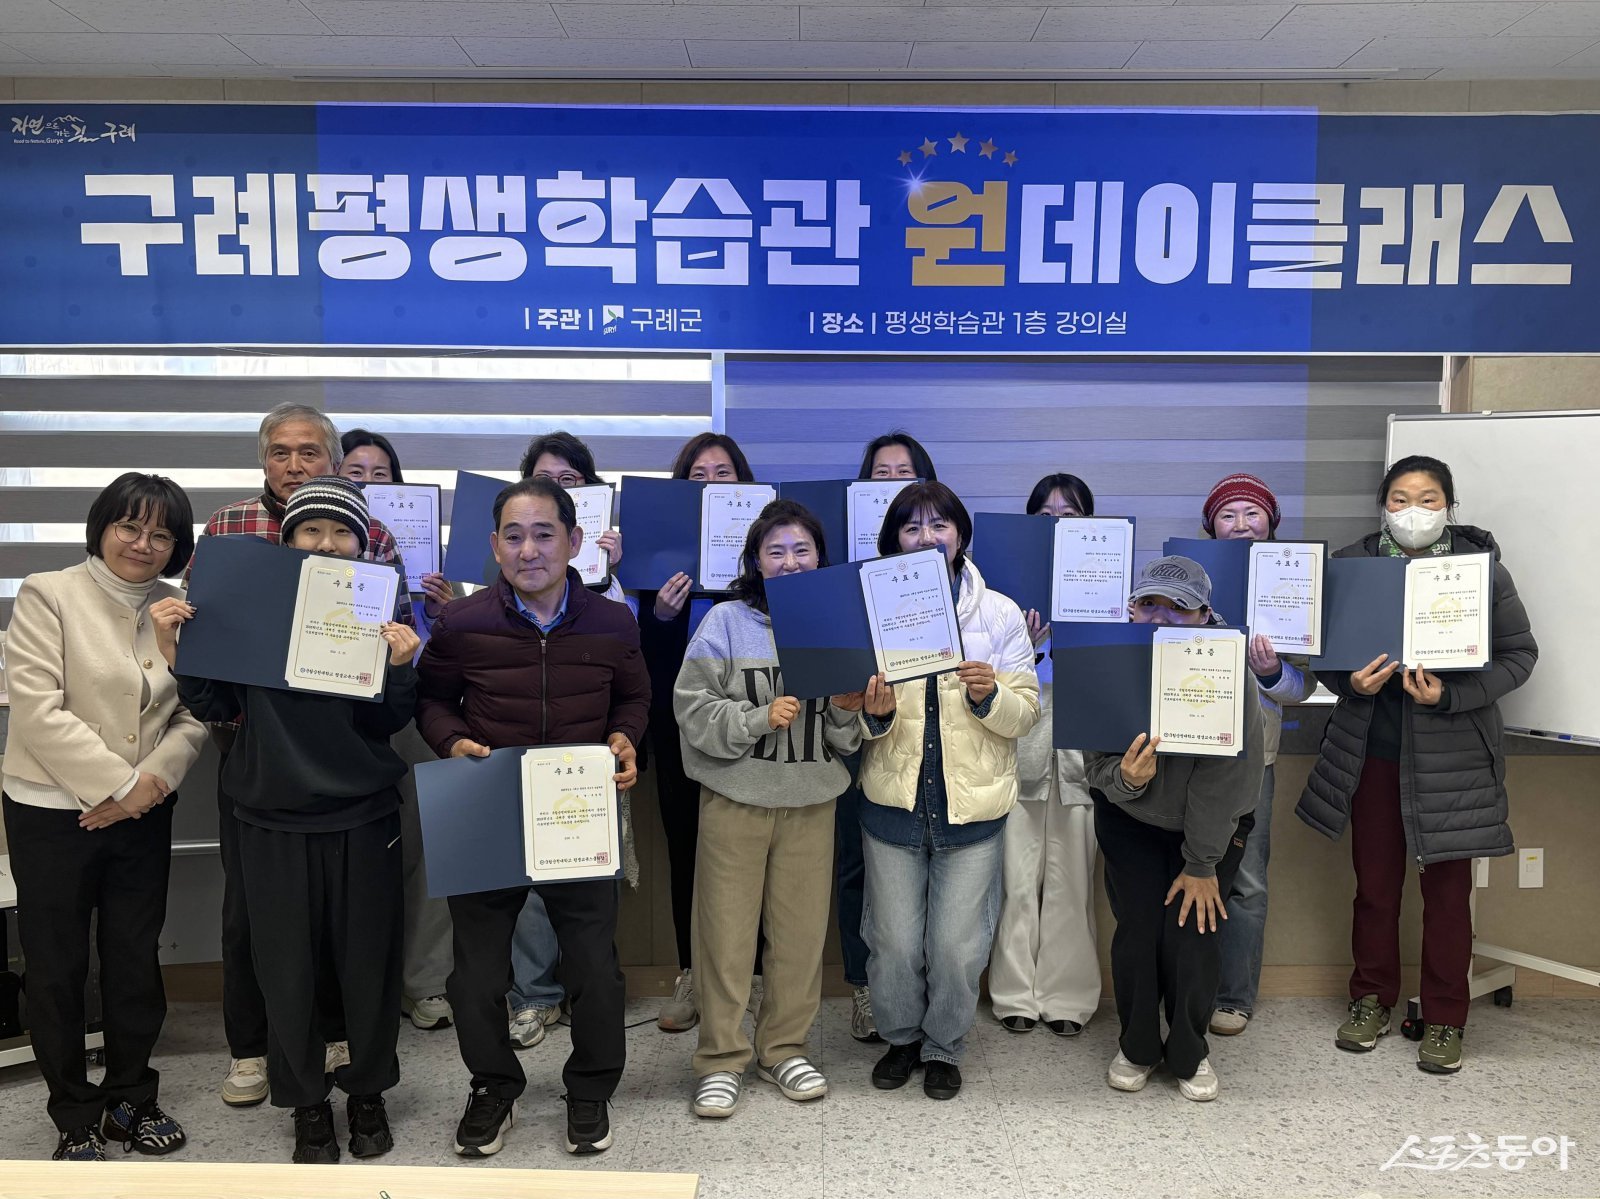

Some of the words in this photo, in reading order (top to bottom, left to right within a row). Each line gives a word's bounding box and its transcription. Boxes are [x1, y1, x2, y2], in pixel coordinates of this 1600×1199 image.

[46, 137, 64, 145] Gurye
[100, 121, 136, 143] 구례
[80, 169, 871, 287] 구례평생학습관
[905, 178, 1575, 290] 원데이클래스
[537, 308, 582, 331] 주관
[631, 308, 703, 333] 구례군
[822, 312, 864, 334] 장소
[885, 310, 1006, 335] 평생학습관
[1012, 310, 1047, 335] 1층
[1056, 310, 1128, 336] 강의실
